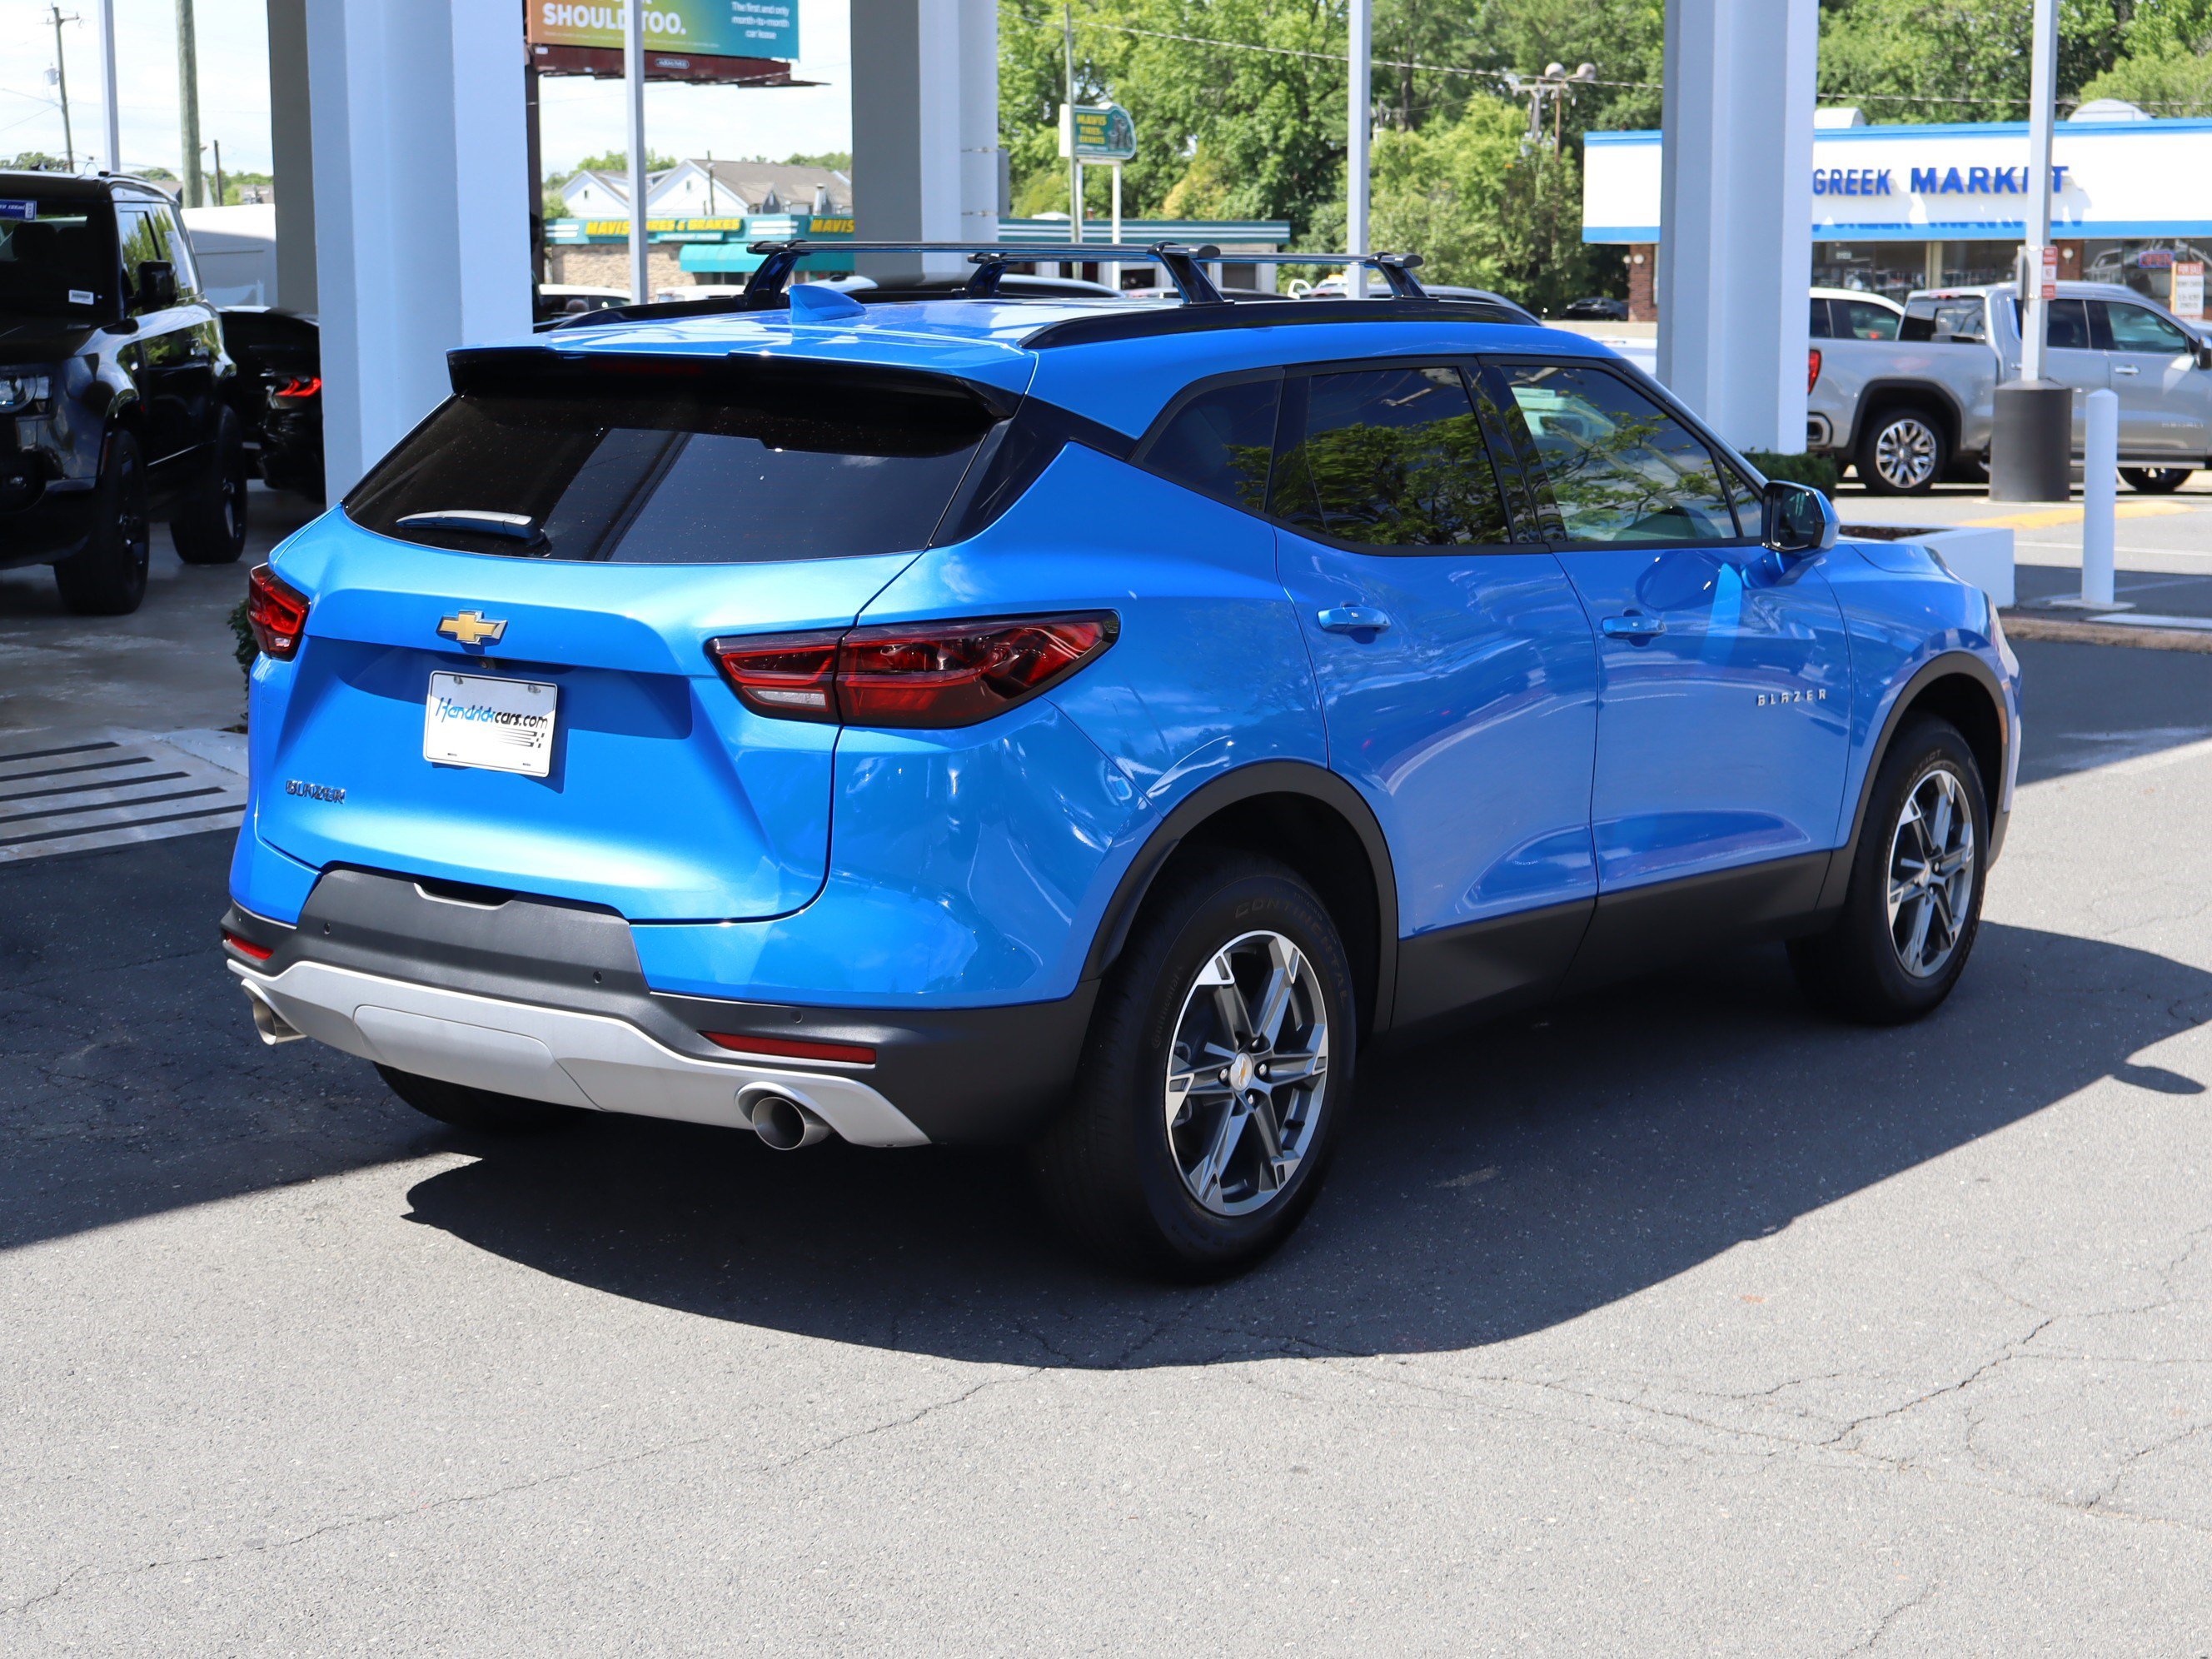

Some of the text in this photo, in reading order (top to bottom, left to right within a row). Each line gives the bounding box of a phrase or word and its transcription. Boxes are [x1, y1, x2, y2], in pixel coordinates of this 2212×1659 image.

[641, 11, 686, 35] TOO.
[1812, 166, 2070, 195] GREEK MARKT
[585, 221, 630, 235] MAVIS
[687, 218, 742, 231] BRAKES
[810, 219, 854, 233] MAVIS
[1757, 688, 1826, 707] BLAZER
[436, 697, 548, 730] Hendrickcars.com
[286, 780, 346, 805] BLAZER
